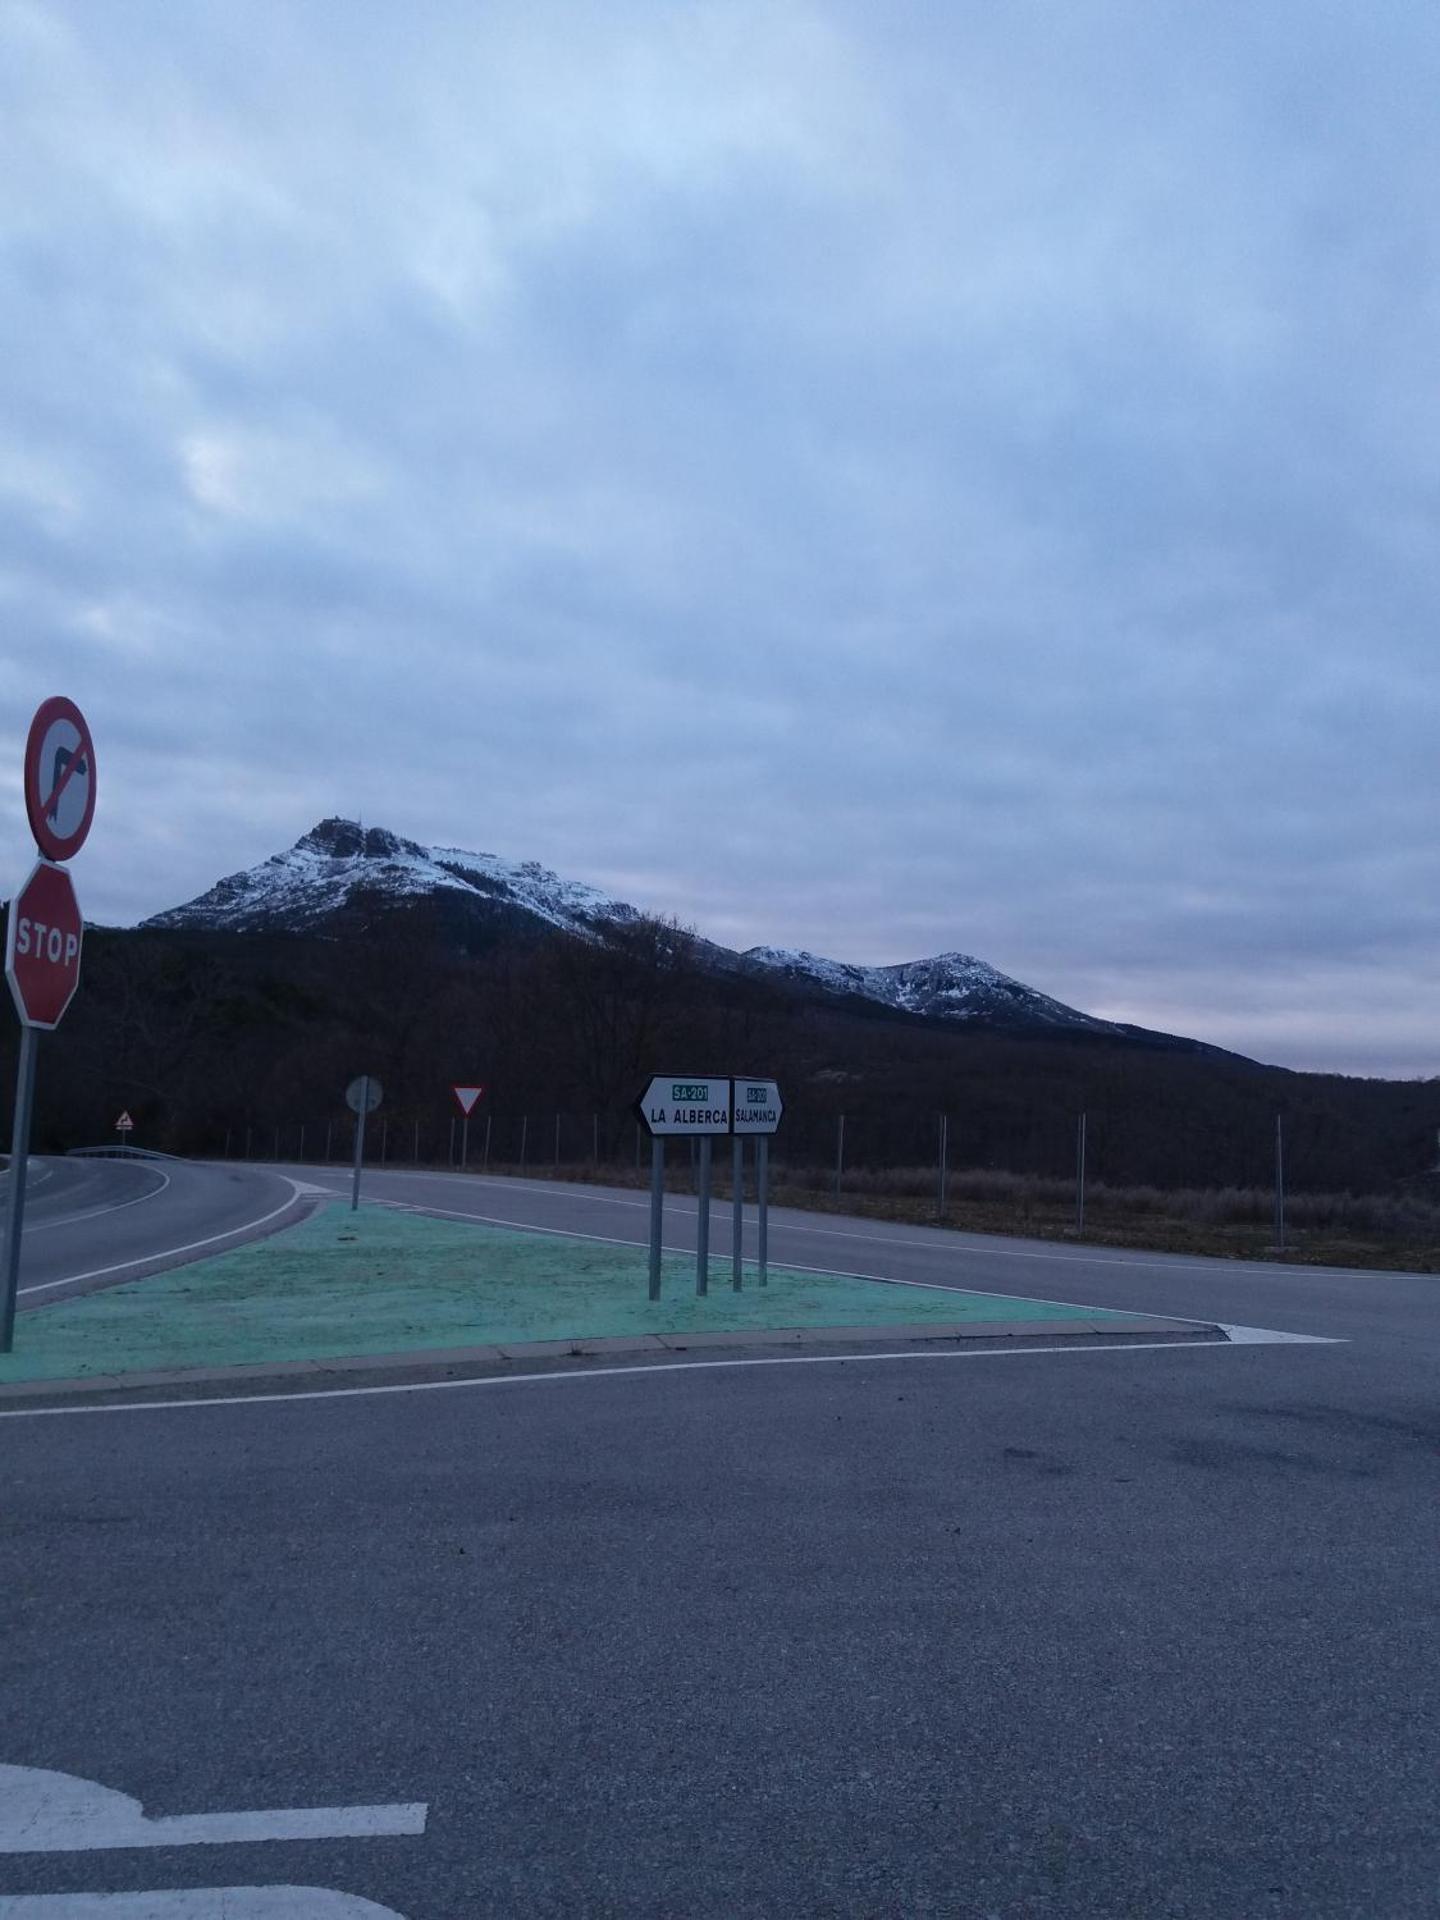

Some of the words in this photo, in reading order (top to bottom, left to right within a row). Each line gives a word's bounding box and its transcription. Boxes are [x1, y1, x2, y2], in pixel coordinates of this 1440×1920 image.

[17, 918, 77, 966] STOP
[651, 1109, 665, 1123] LA
[674, 1109, 727, 1124] ALBERCA
[736, 1109, 776, 1123] SALAMANCA
